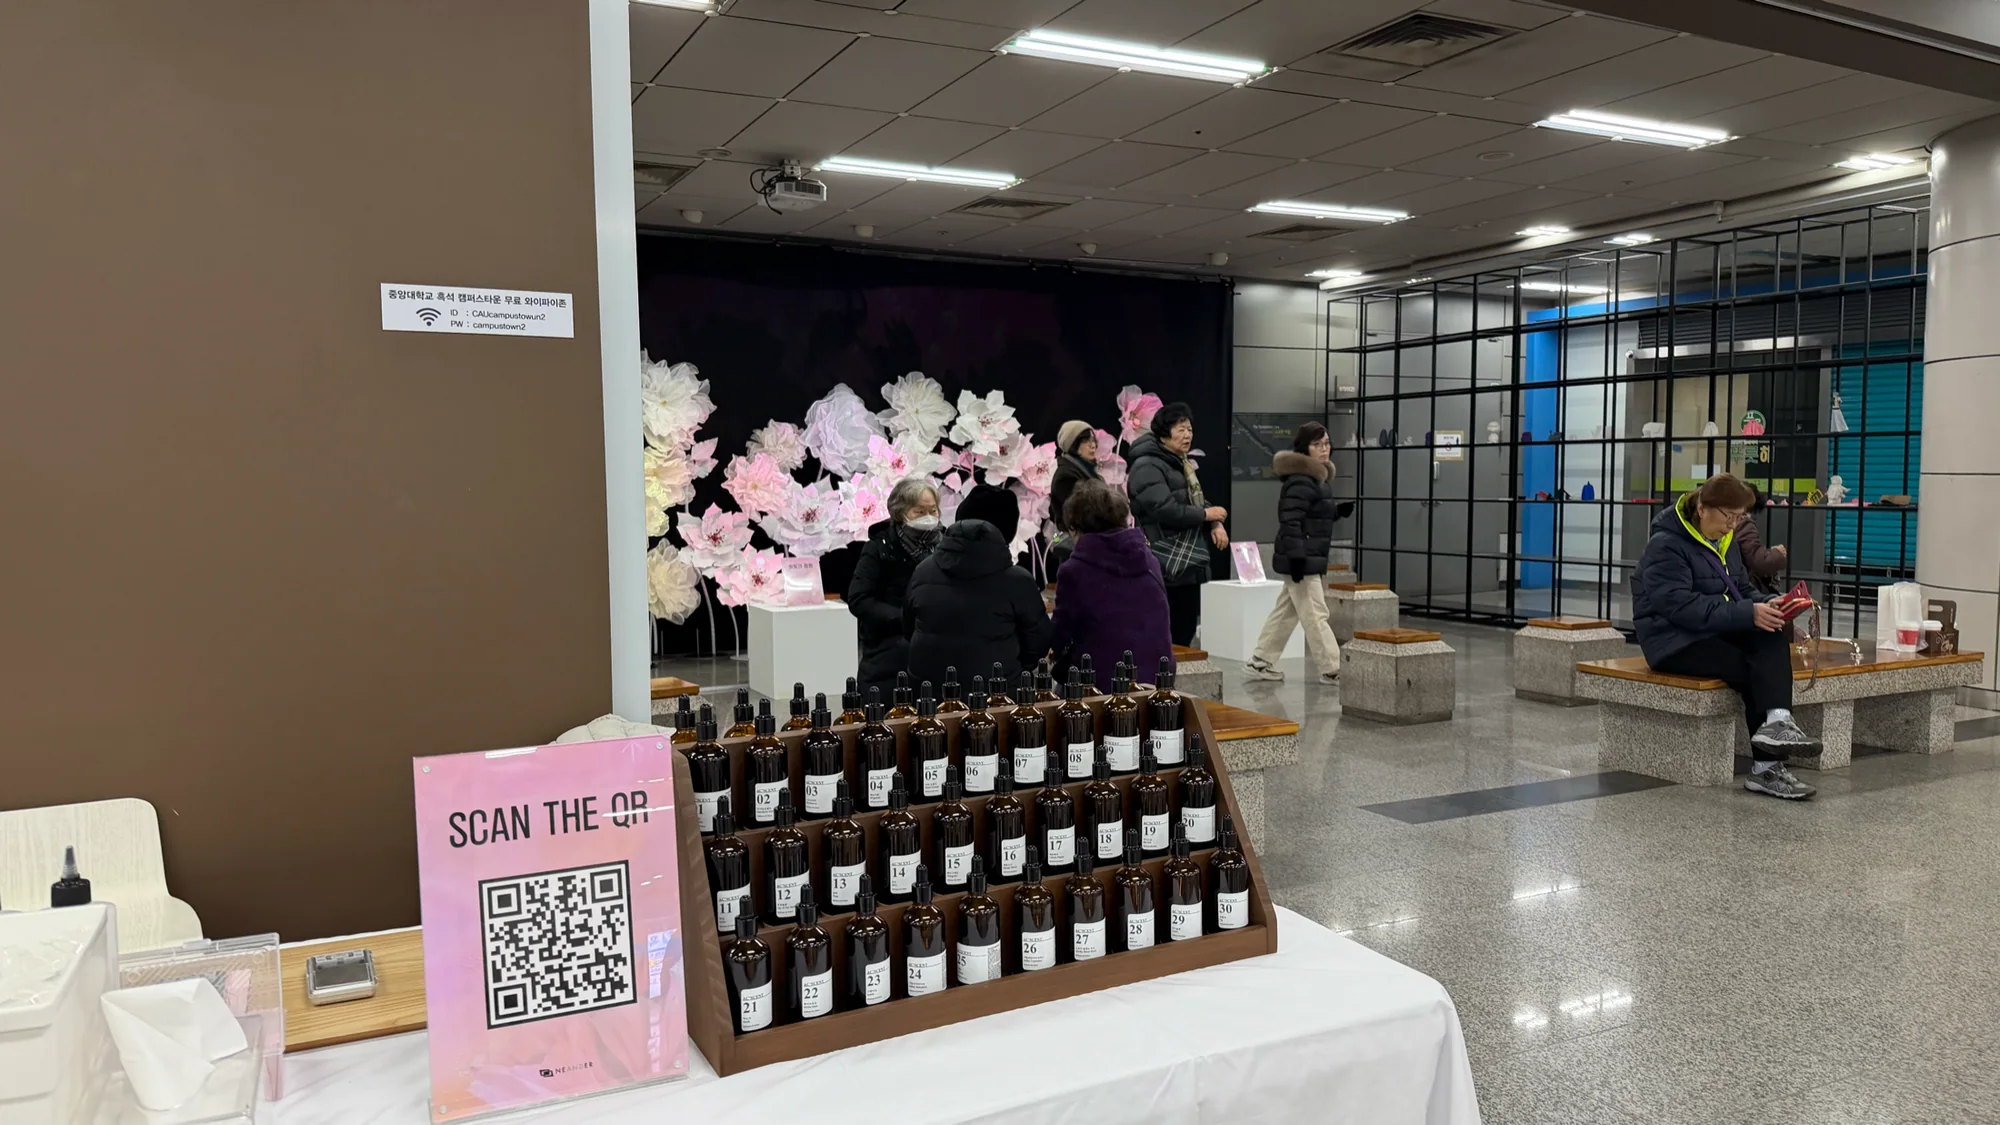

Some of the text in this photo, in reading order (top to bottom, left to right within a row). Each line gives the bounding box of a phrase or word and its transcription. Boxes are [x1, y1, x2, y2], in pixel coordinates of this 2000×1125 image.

[388, 289, 567, 308] 중앙대학교 흑석 캠퍼스타운 무료 와이파이존
[472, 310, 546, 320] CAUcampustowun2
[473, 322, 526, 330] campustown2
[1015, 758, 1027, 768] 07
[1069, 754, 1082, 763] 08
[925, 770, 938, 780] 05
[966, 766, 978, 776] 06
[806, 786, 818, 796] 03
[870, 781, 883, 791] 04
[757, 794, 770, 804] 02
[698, 804, 703, 815] 1
[449, 790, 649, 848] SCAN THE QR
[1183, 818, 1194, 828] 20
[1144, 826, 1156, 836] 19
[1100, 834, 1112, 844] 18
[1050, 841, 1062, 851] 17
[1004, 852, 1016, 862] 16
[947, 858, 960, 869] 15
[892, 867, 905, 877] 14
[833, 878, 847, 889] 13
[778, 889, 791, 900] 12
[720, 903, 732, 914] 11
[1219, 904, 1232, 914] 30
[1172, 914, 1185, 925] 29
[1129, 924, 1142, 934] 28
[1076, 934, 1089, 944] 27
[1023, 943, 1037, 954] 26
[957, 954, 967, 967] 25
[909, 968, 922, 979] 24
[867, 974, 881, 987] 23
[804, 987, 819, 999] 22
[743, 1001, 757, 1014] 21
[555, 1061, 593, 1074] NEANDER
